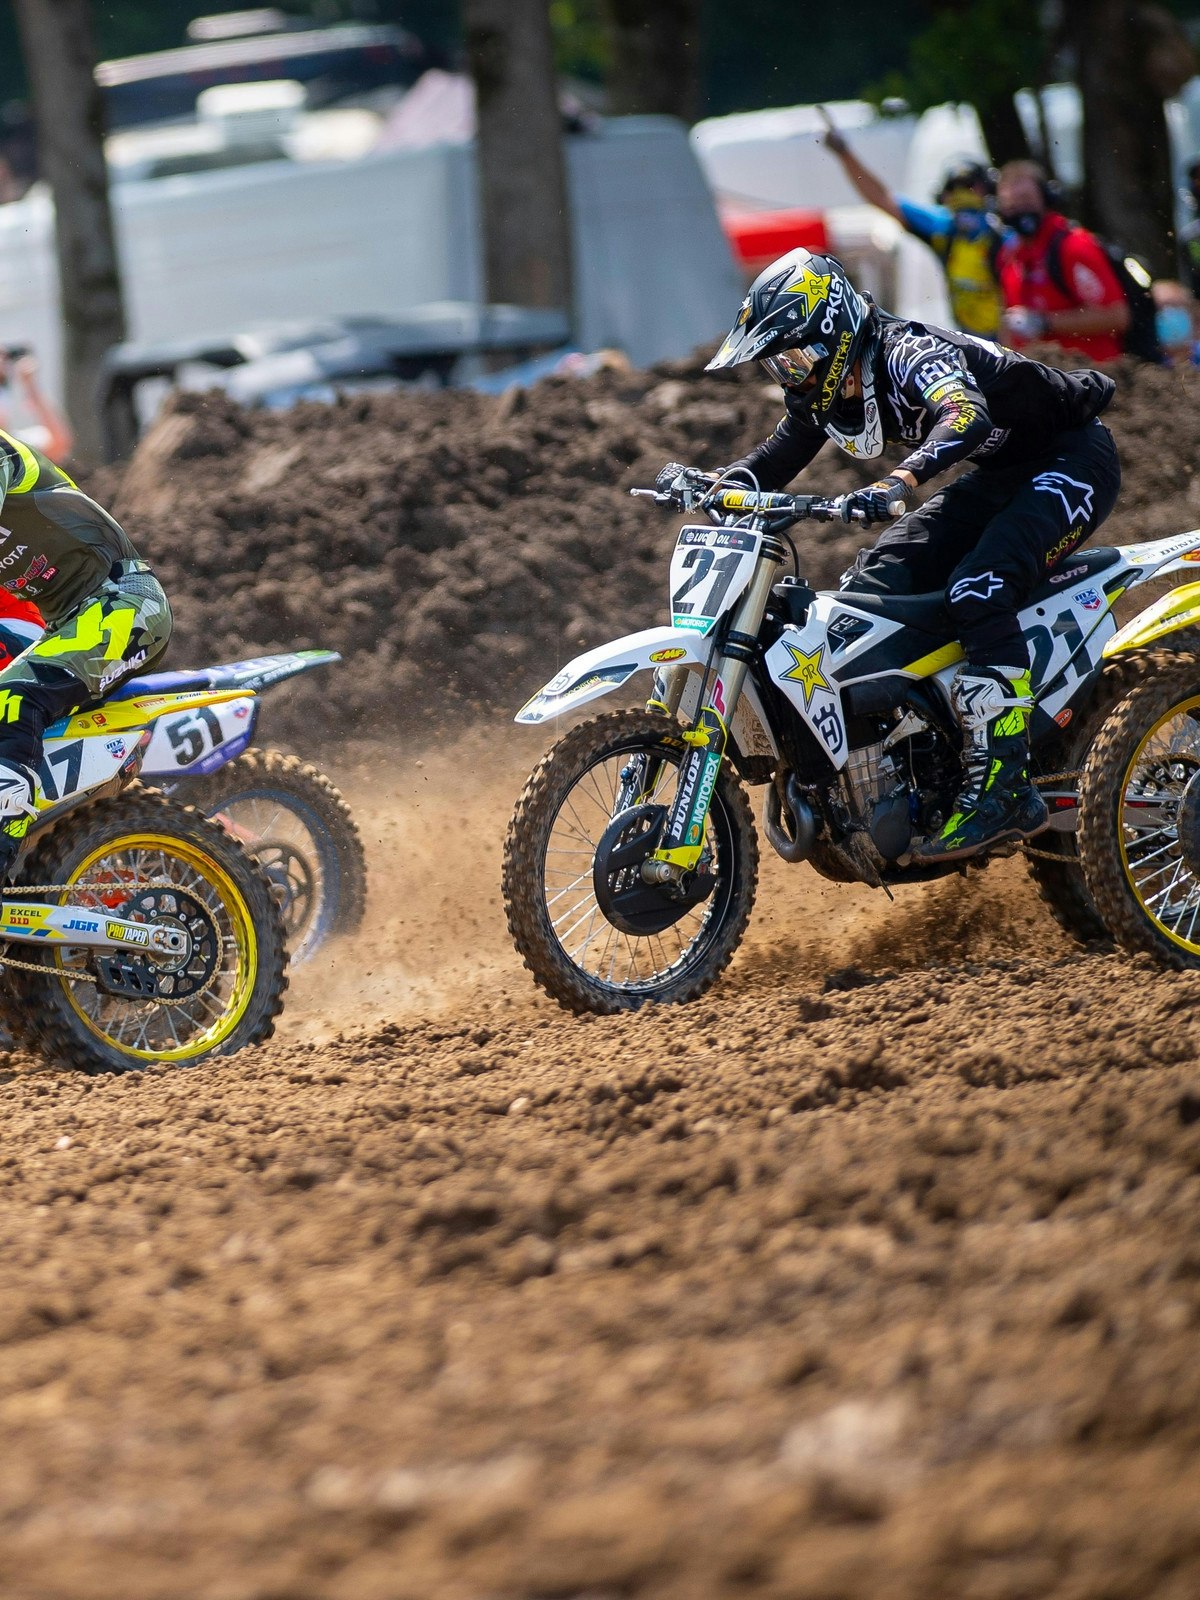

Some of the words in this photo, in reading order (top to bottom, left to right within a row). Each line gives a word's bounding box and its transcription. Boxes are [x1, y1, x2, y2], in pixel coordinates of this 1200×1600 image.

[821, 271, 844, 334] OAKLEY
[753, 330, 779, 350] Airoh
[693, 531, 715, 545] LUC
[716, 533, 731, 545] OIL
[672, 548, 744, 618] 21
[1049, 564, 1089, 583] GUTS
[682, 618, 709, 628] MOTOREX
[651, 648, 686, 662] FMF
[1022, 608, 1094, 699] 21
[100, 649, 147, 690] SUZUKI
[165, 706, 224, 766] 51
[671, 752, 700, 840] DUNLOP
[692, 757, 720, 824] MOTOREX
[10, 908, 42, 917] EXCEL
[62, 919, 99, 932] JGR
